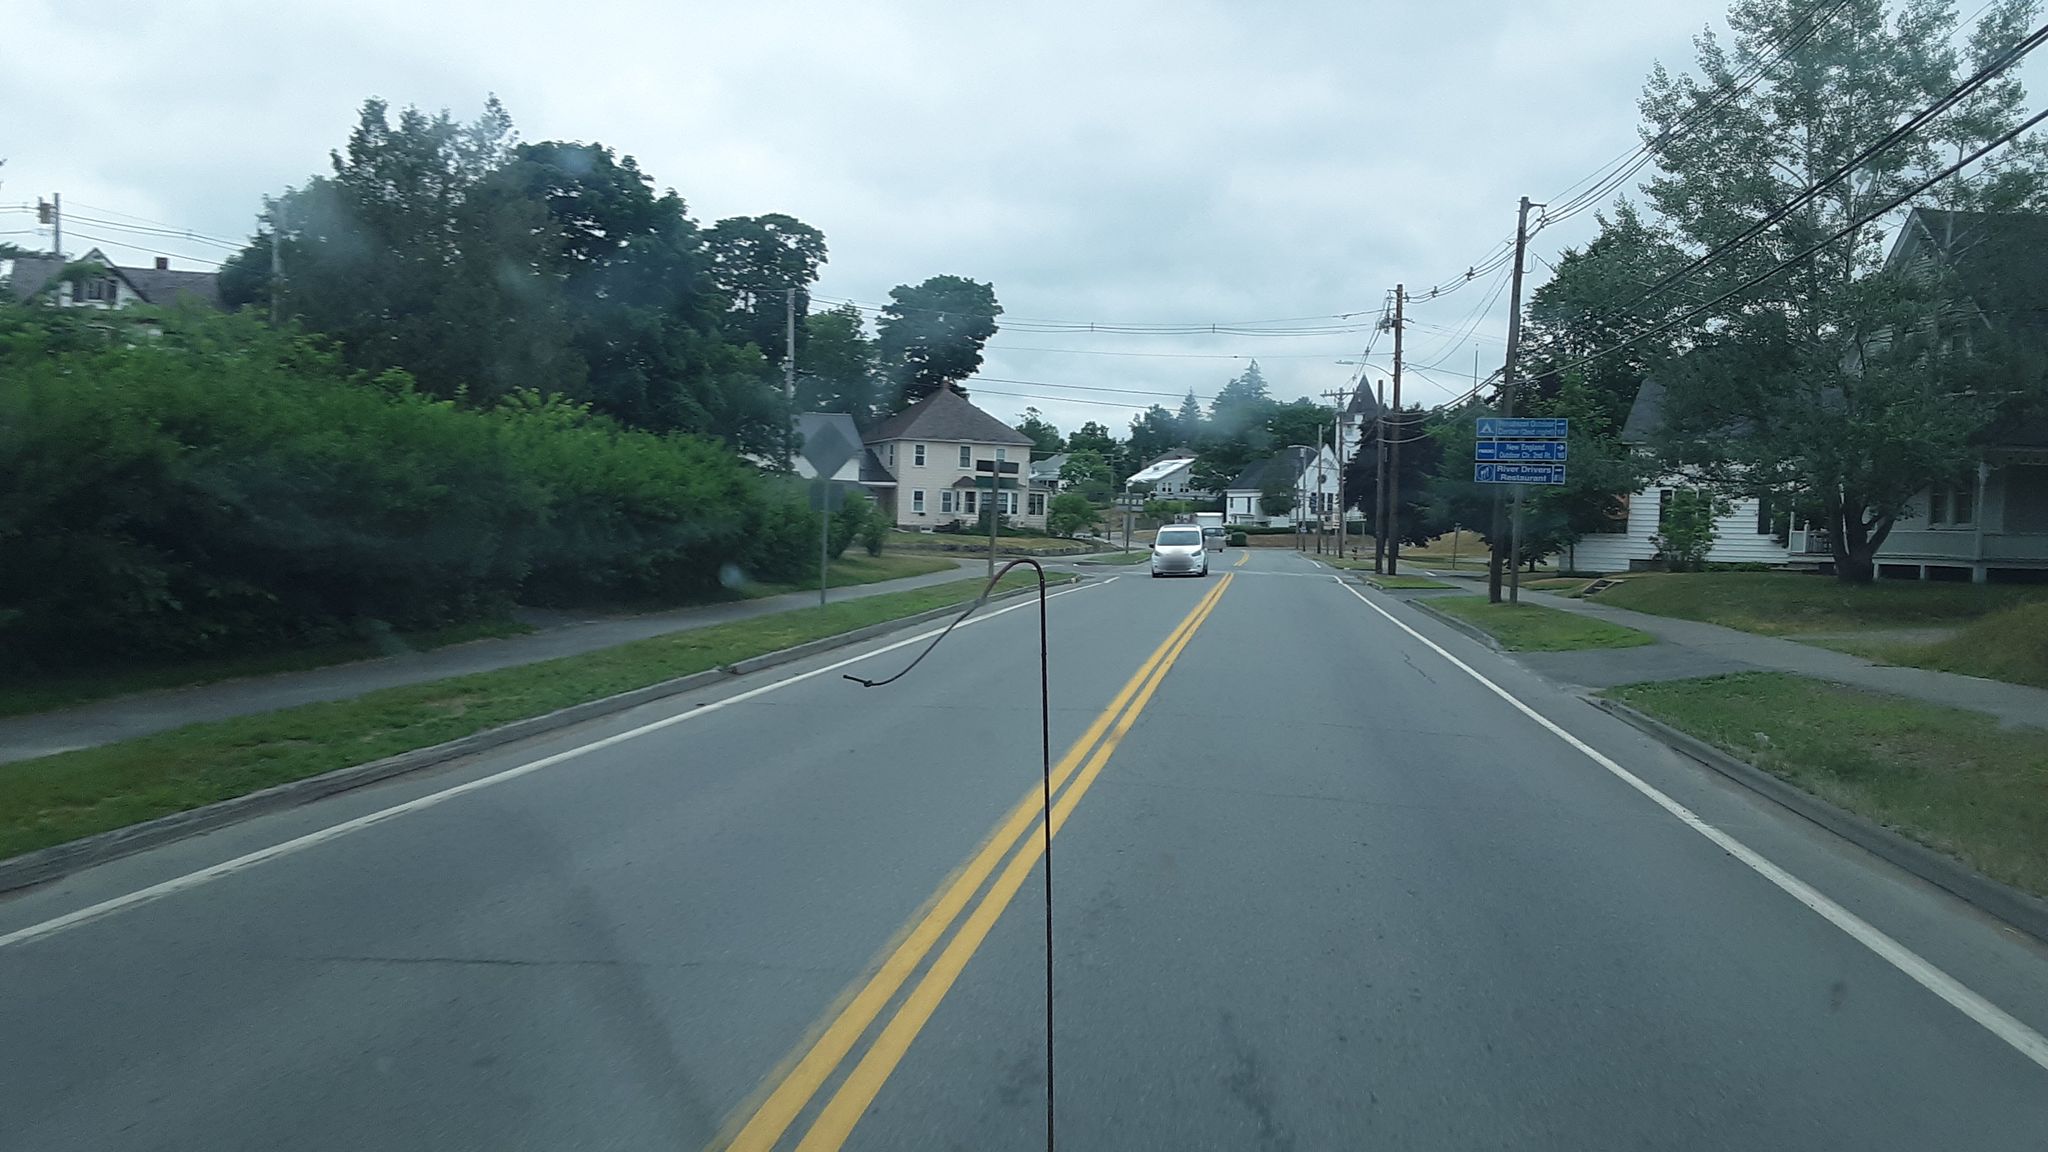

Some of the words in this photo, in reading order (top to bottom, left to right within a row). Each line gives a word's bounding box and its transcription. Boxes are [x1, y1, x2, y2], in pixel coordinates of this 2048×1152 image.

[1521, 444, 1545, 452] England
[1521, 465, 1552, 473] Drivers
[1500, 474, 1547, 482] Restaurant
